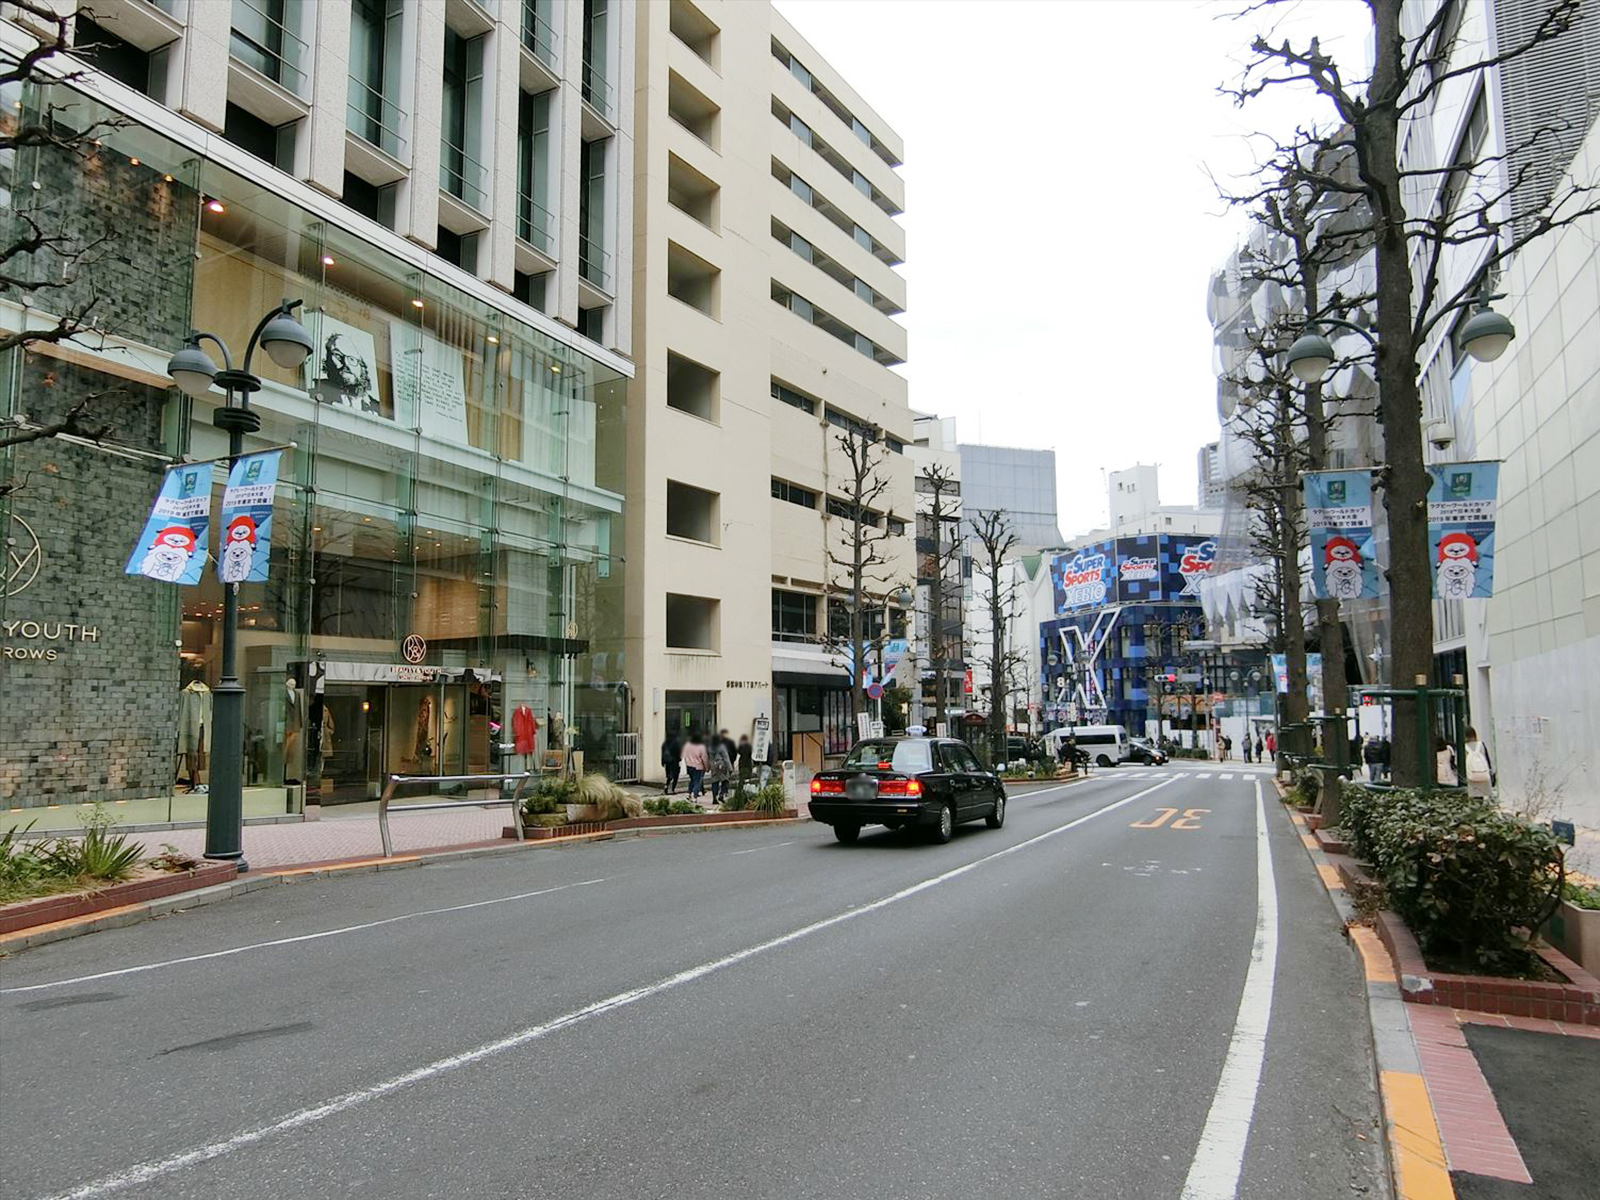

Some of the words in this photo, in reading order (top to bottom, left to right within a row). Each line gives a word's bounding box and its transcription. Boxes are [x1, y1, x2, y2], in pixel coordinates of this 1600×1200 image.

[1073, 555, 1104, 574] SUPER
[1121, 563, 1155, 572] SPORTS
[1130, 557, 1156, 565] SUPER
[1064, 568, 1100, 588] SPORTS
[1065, 581, 1107, 607] XEBIO
[5, 620, 97, 642] YOUTH
[4, 646, 58, 661] ROWS
